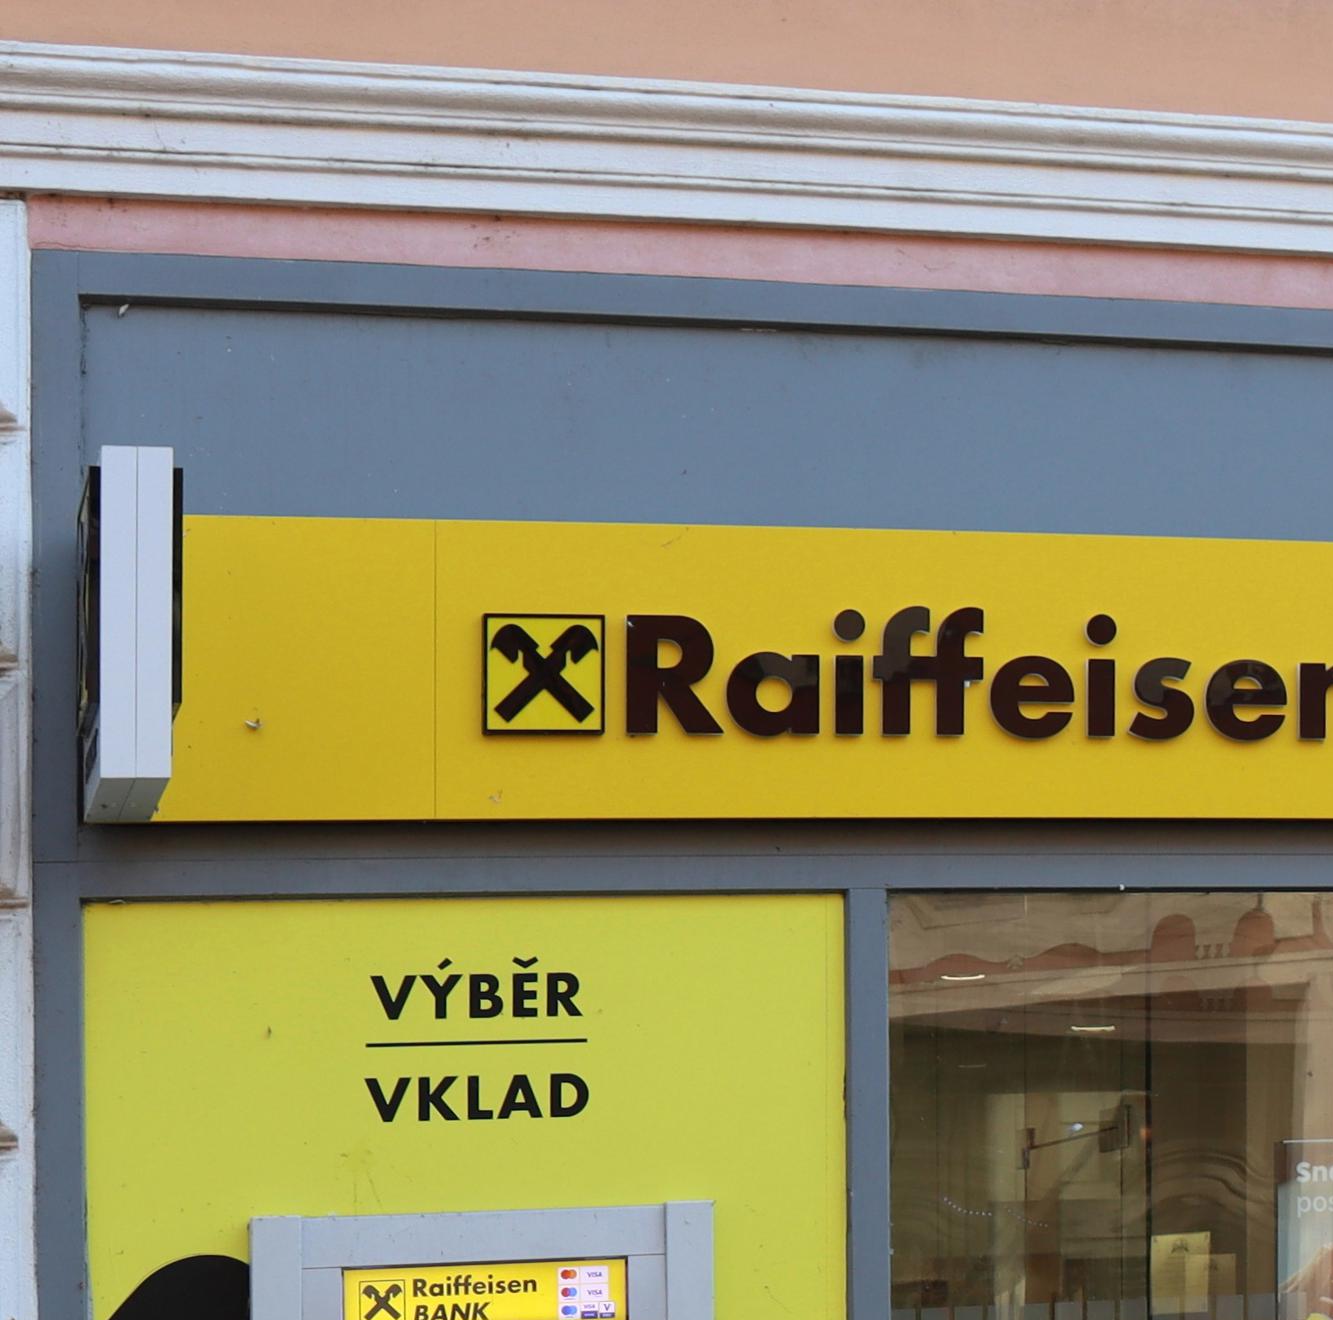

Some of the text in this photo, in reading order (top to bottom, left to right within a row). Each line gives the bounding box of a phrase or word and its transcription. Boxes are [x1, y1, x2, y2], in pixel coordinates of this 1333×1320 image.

[371, 956, 584, 1021] VÝBĚR
[365, 1073, 589, 1123] VKLAD
[412, 1274, 537, 1298] Raiffeisen
